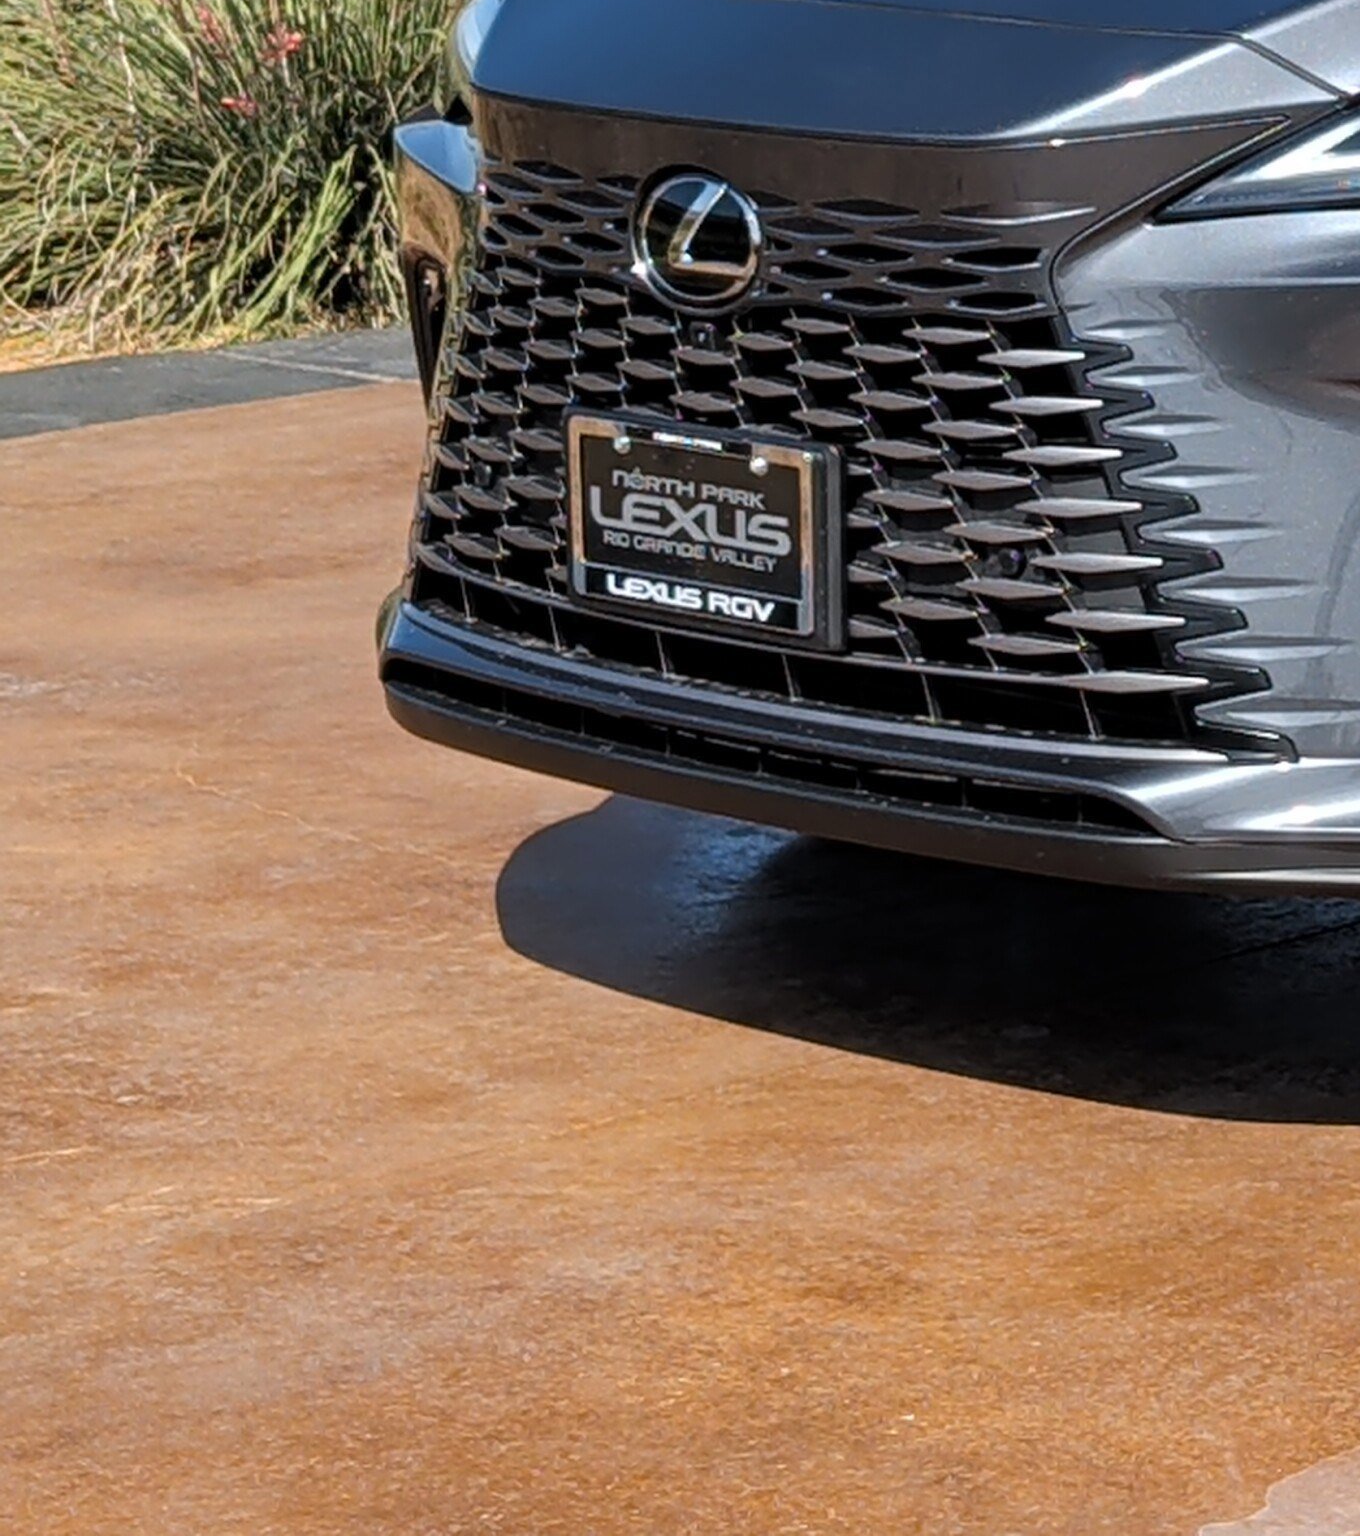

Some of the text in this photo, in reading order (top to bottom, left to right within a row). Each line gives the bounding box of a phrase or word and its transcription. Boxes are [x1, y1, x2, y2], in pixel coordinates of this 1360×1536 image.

[700, 483, 766, 511] PARK
[589, 485, 792, 557] LEXUS
[602, 529, 778, 574] RIO GRANDE VALLEY
[606, 573, 776, 623] LEXUS RGV
